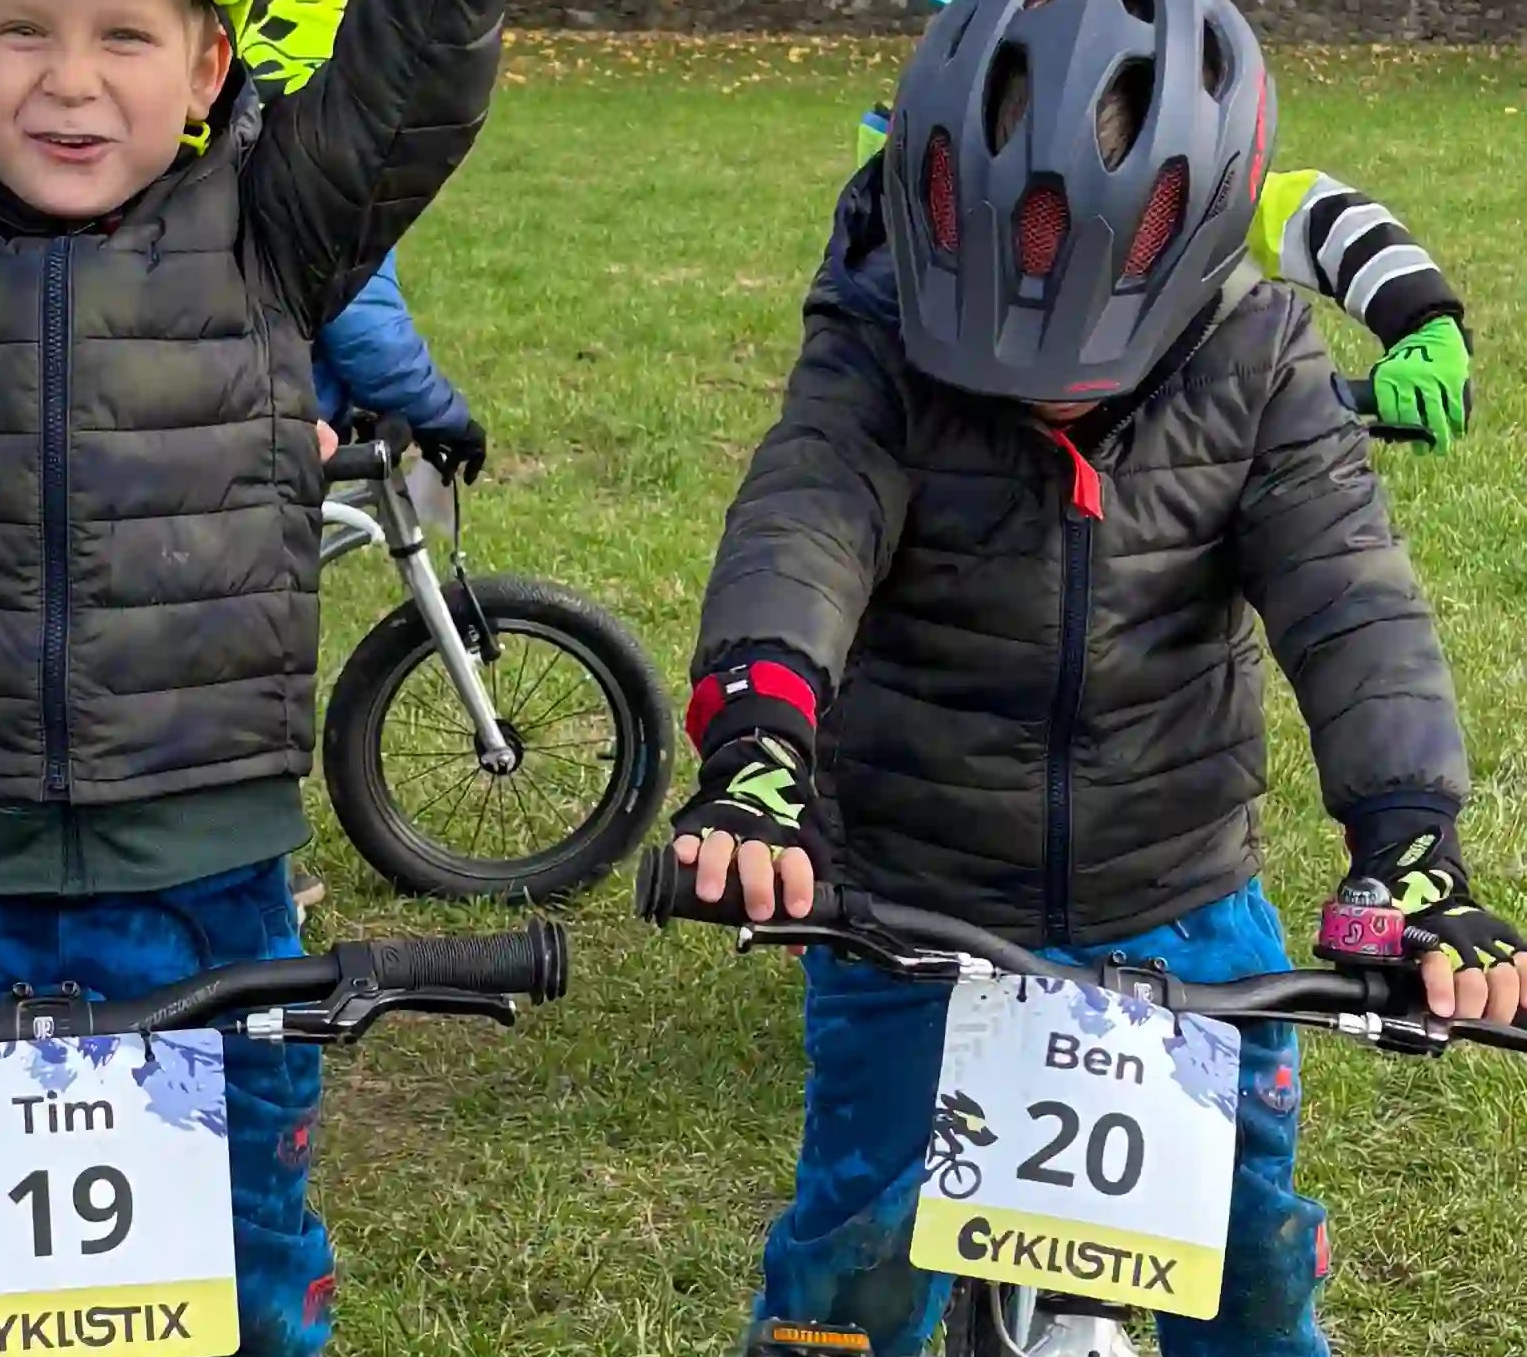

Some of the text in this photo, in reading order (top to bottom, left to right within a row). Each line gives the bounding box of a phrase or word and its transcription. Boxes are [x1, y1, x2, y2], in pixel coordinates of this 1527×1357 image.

[1045, 1031, 1144, 1085] Ben
[11, 1089, 114, 1134] Tim
[1016, 1100, 1145, 1196] 20
[7, 1164, 133, 1257] 19
